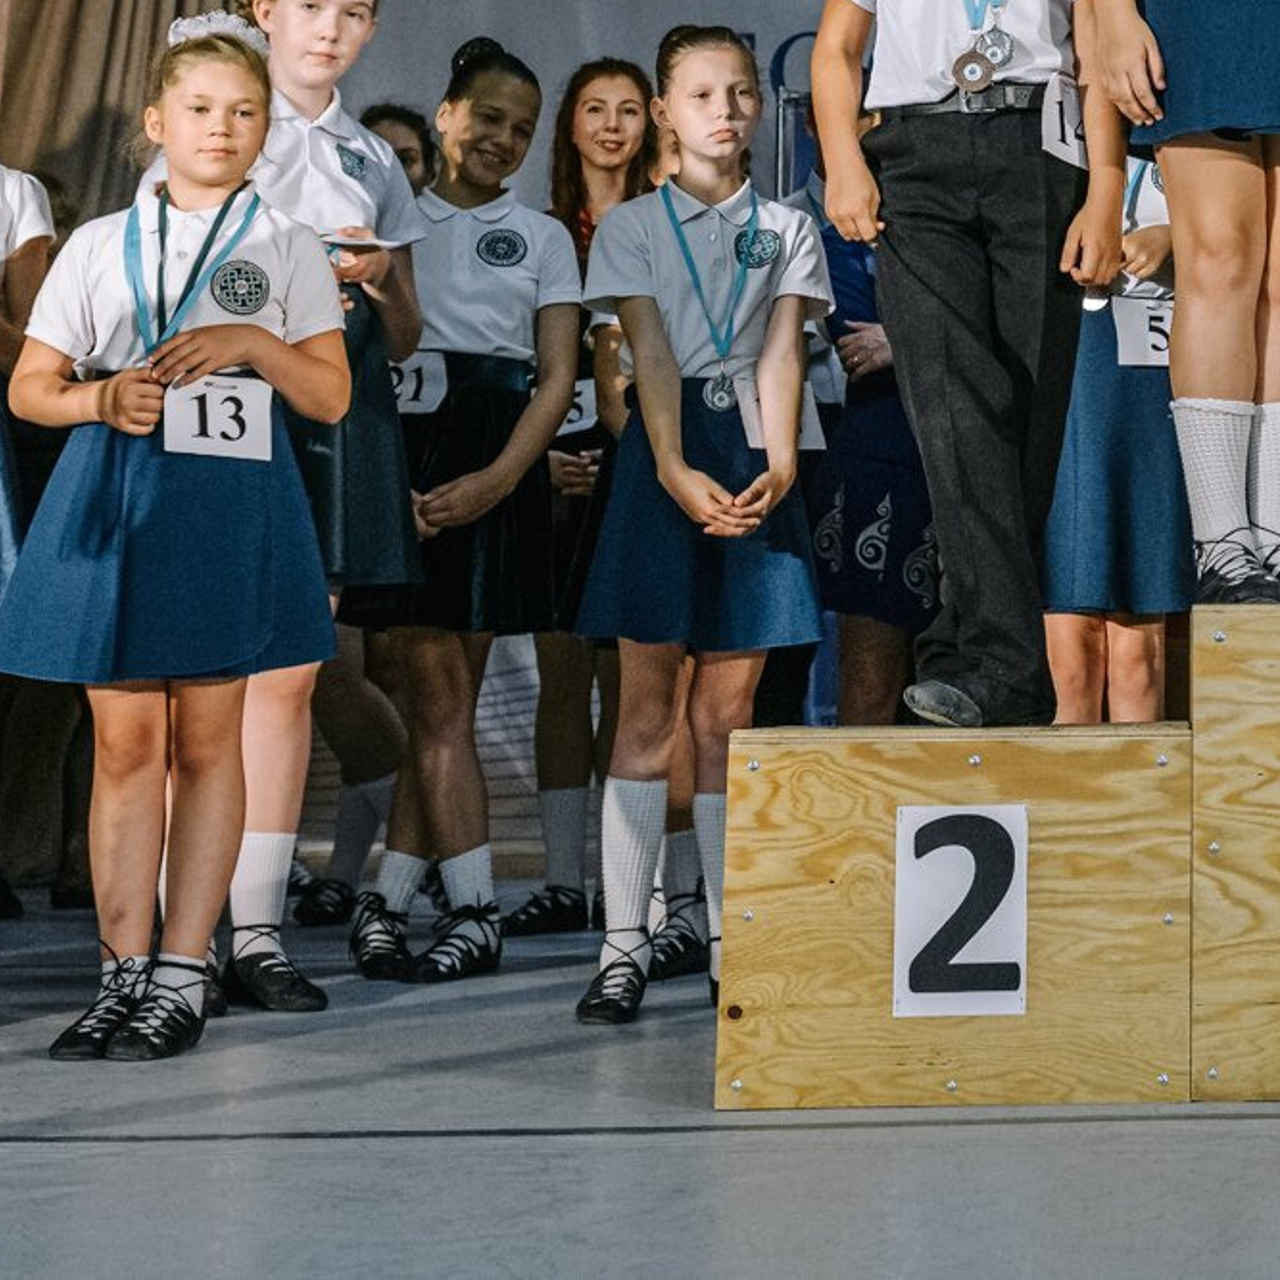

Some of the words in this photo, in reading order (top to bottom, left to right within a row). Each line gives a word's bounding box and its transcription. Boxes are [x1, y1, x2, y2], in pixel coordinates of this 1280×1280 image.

[1148, 315, 1170, 352] 5
[189, 392, 247, 442] 13
[908, 813, 1021, 994] 2
